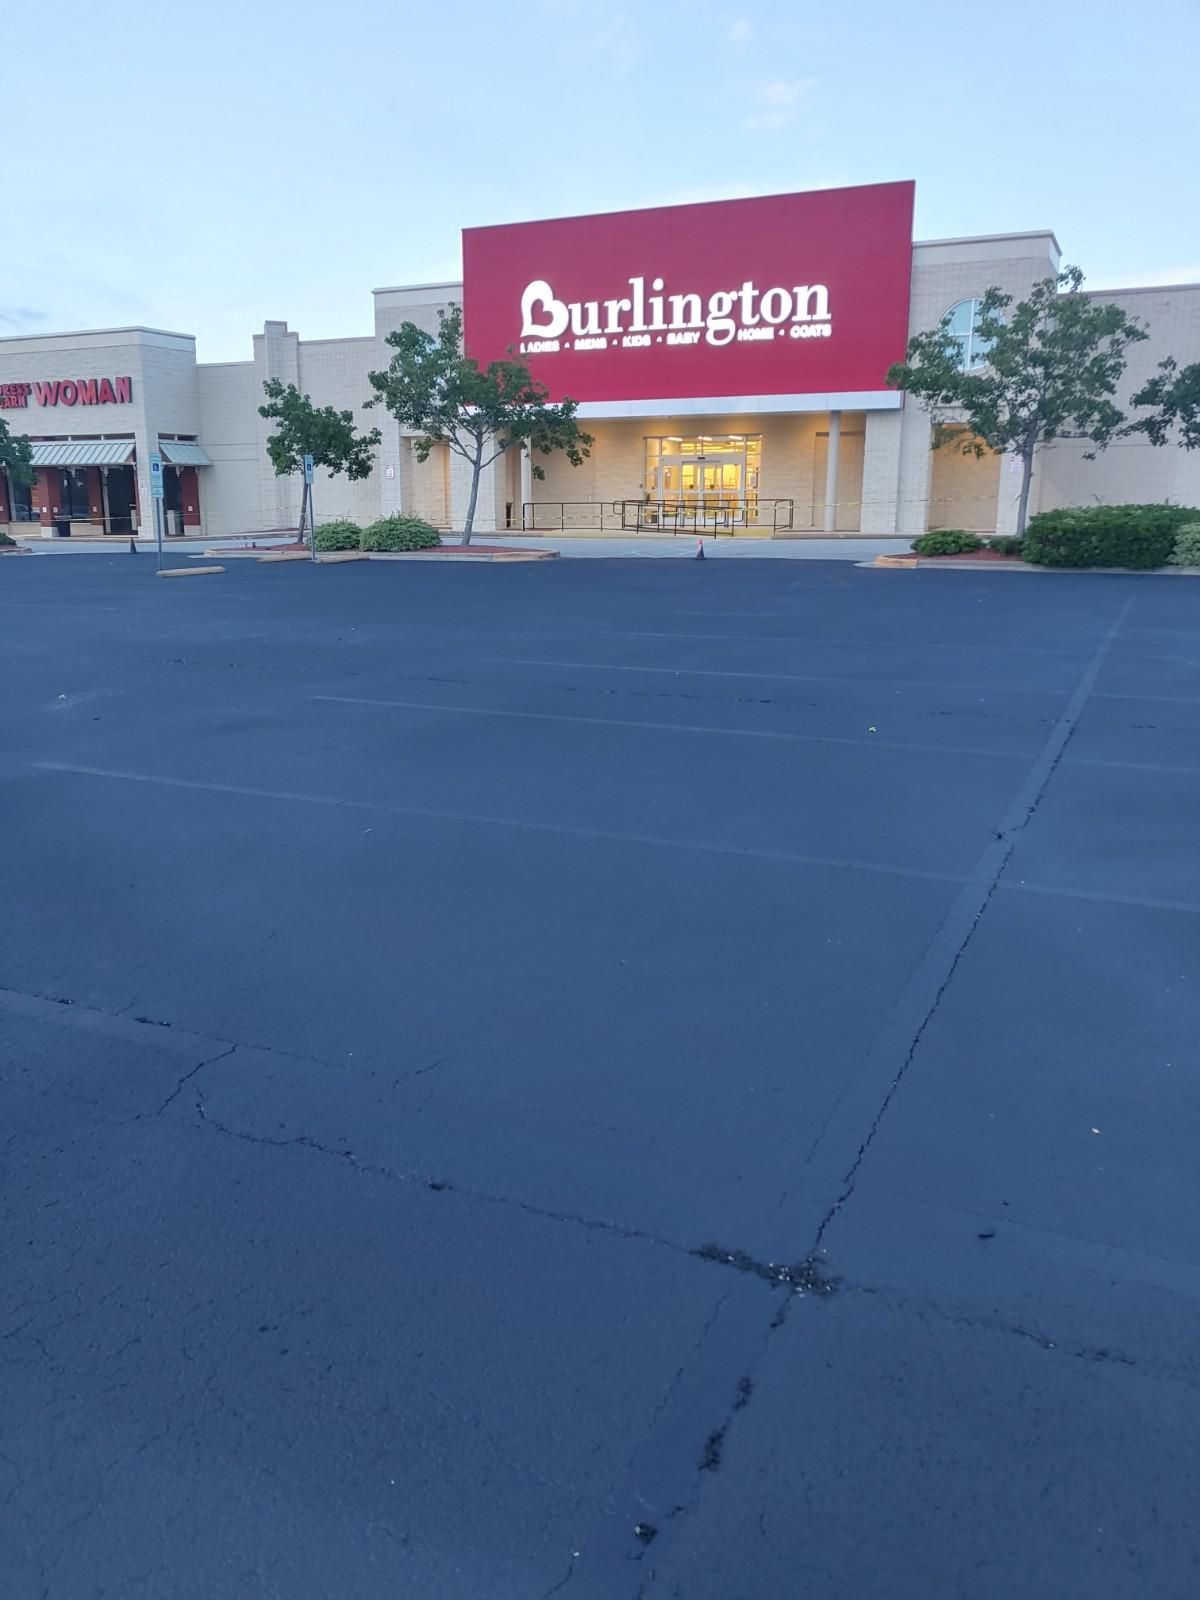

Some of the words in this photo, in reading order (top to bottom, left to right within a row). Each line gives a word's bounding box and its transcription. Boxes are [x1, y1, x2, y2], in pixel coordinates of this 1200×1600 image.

[520, 276, 832, 346] Burlington
[520, 340, 560, 353] LADIES
[622, 334, 651, 347] KIDS
[666, 331, 701, 345] BABY
[737, 326, 775, 341] HOME
[789, 323, 832, 338] COATS
[32, 376, 132, 407] WOMAN
